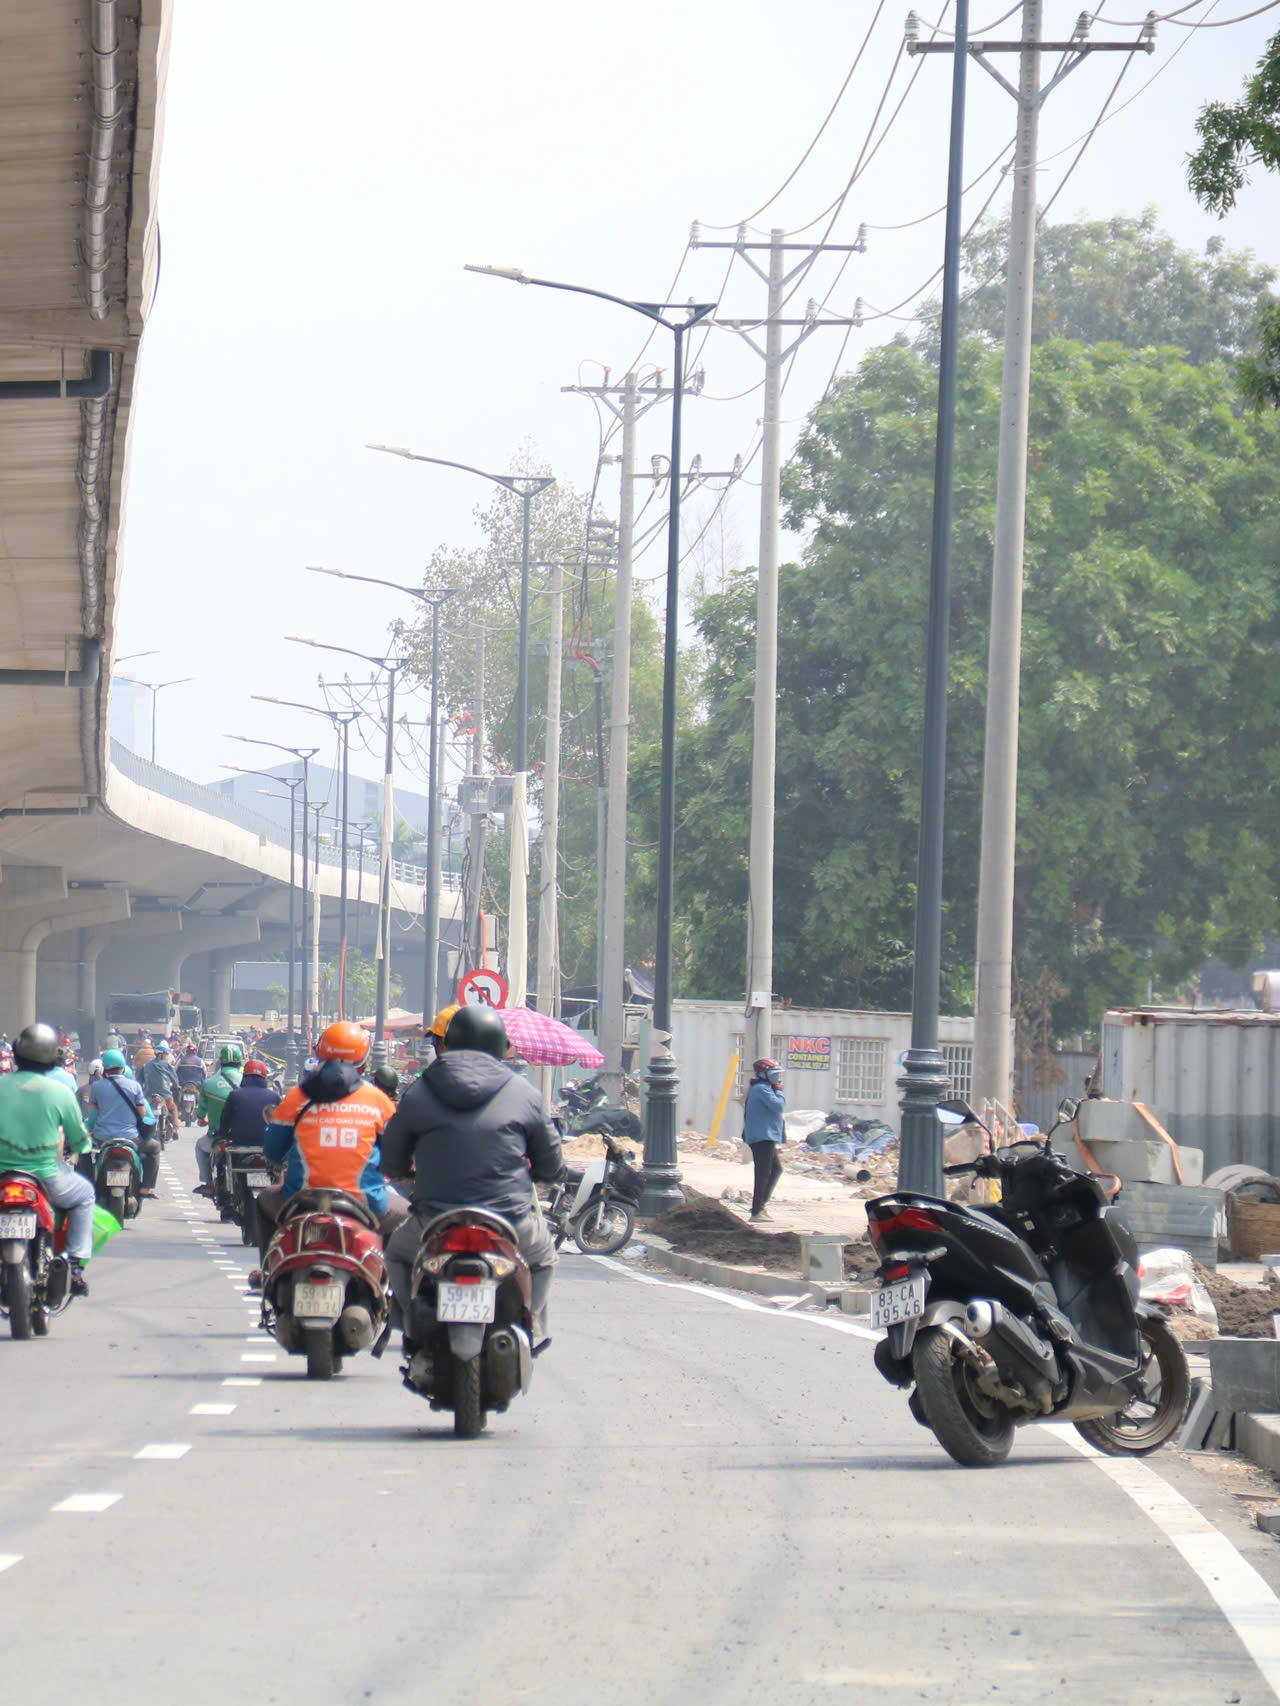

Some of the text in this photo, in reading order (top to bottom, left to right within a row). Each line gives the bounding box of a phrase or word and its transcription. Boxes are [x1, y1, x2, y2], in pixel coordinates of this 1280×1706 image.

[788, 1037, 830, 1053] NKC
[787, 1053, 830, 1063] CONTAINER
[879, 1283, 915, 1307] 83-CA
[442, 1303, 490, 1320] 717.52
[874, 1299, 921, 1325] 195.46
